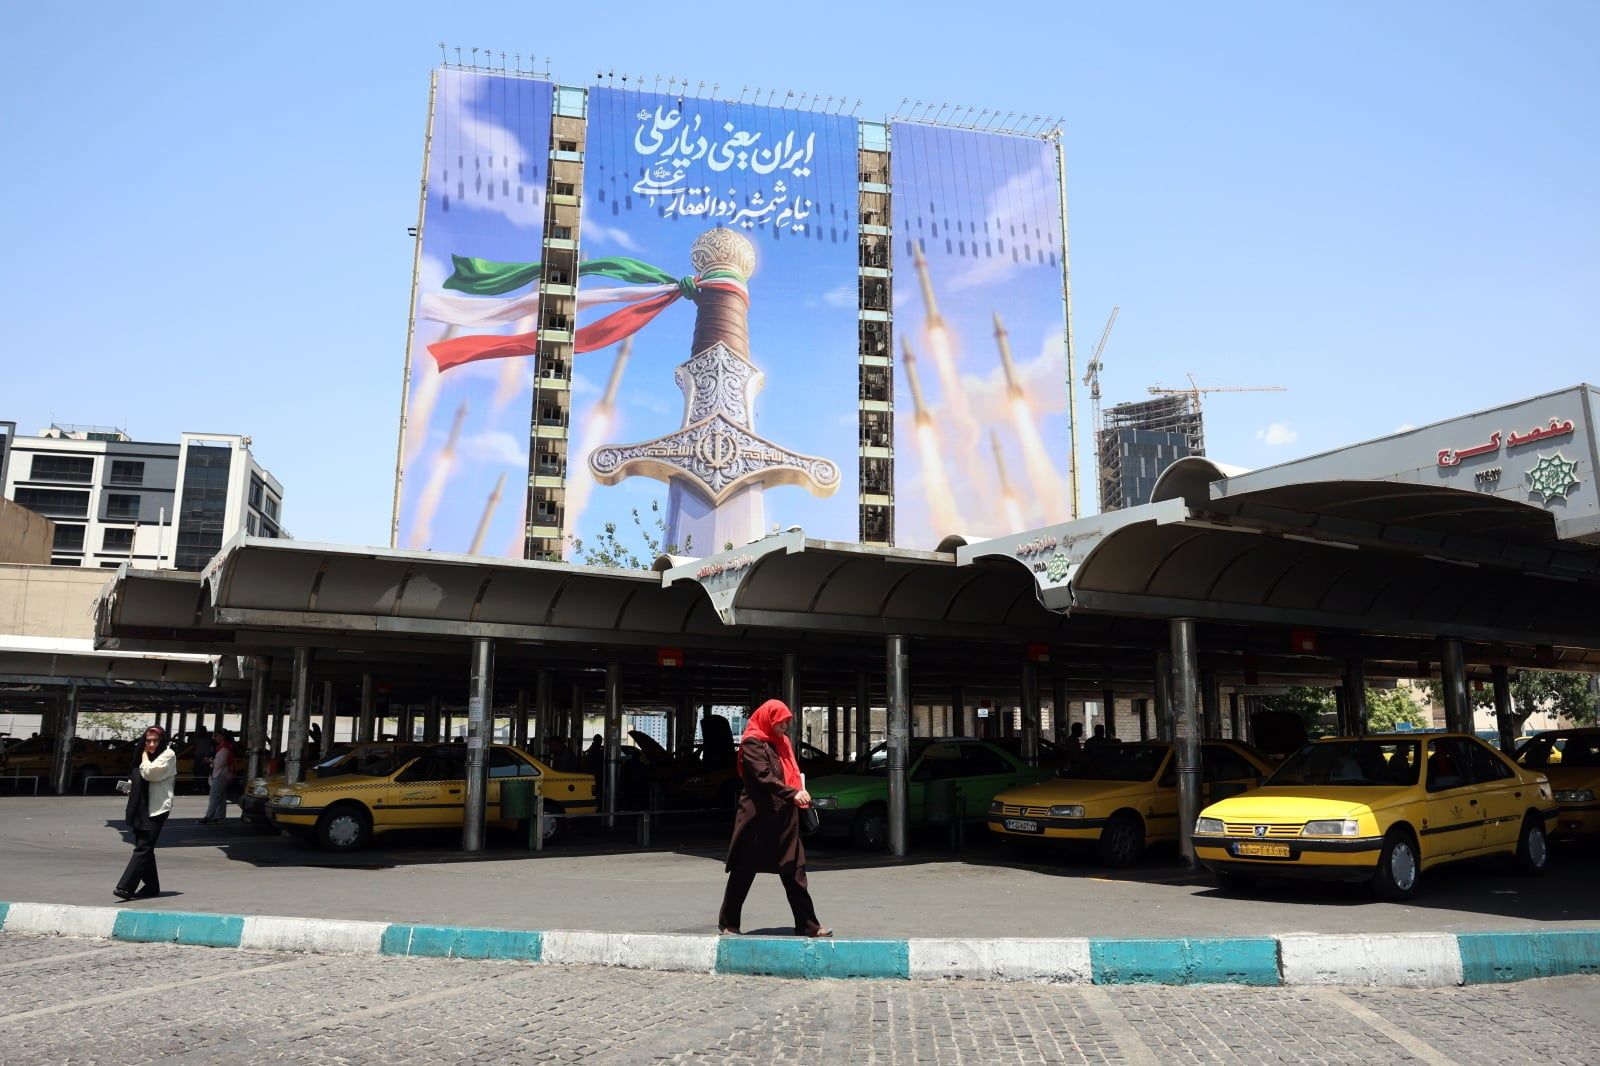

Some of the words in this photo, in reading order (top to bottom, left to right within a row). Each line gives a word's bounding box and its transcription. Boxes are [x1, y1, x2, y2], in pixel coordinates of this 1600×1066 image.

[634, 105, 682, 155] علی
[707, 122, 762, 171] یعنی
[751, 130, 815, 177] ایران
[1437, 431, 1502, 468] کرج
[1506, 416, 1575, 449] مقصد
